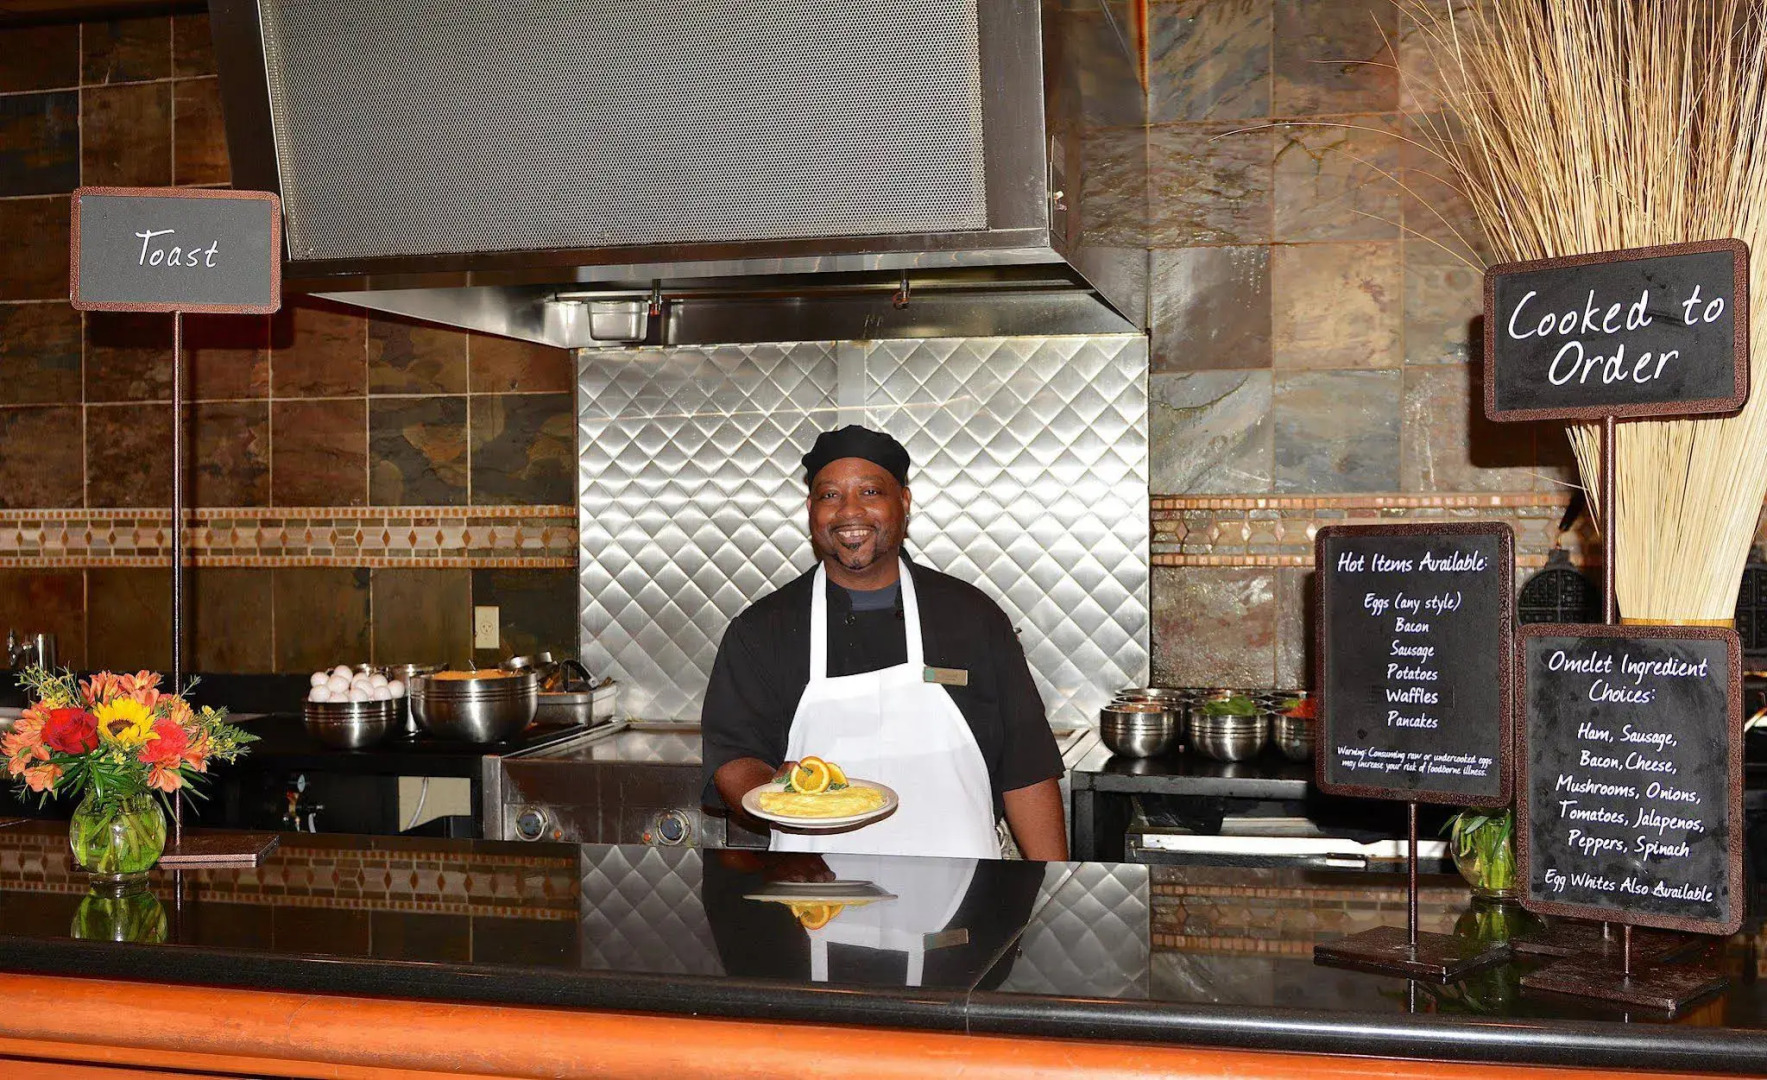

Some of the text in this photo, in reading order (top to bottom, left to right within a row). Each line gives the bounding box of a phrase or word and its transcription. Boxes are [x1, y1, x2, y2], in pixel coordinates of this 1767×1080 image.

[134, 229, 219, 268] Toast
[1507, 284, 1725, 340] Cooked to
[1548, 340, 1680, 386] Order
[1337, 550, 1489, 573] Hot Items Available:
[1364, 590, 1462, 616] Eggs (any style)
[1394, 616, 1430, 633] Bacon
[1390, 639, 1434, 664] Sausage
[1386, 662, 1438, 681] Potatoes
[1548, 650, 1708, 685] Omelet Ingredient
[1385, 686, 1439, 704] Waffles
[1588, 680, 1656, 704] Choices:
[1387, 710, 1438, 729] Pancakes
[1577, 722, 1678, 752] Ham, Sausage,
[1341, 759, 1487, 777] may increase your risk of foodborne illness.
[1368, 746, 1406, 763] Consuming
[1407, 752, 1422, 761] raw
[1423, 753, 1432, 761] or
[1433, 754, 1477, 765] undercooked
[1478, 757, 1493, 769] eggs
[1555, 774, 1701, 804] Mushrooms, Onions,
[1559, 800, 1705, 836] Tomatoes, Jalapenos,
[1567, 829, 1690, 862] Peppers, Spinach
[1545, 869, 1714, 903] Egg Whites Also Available
